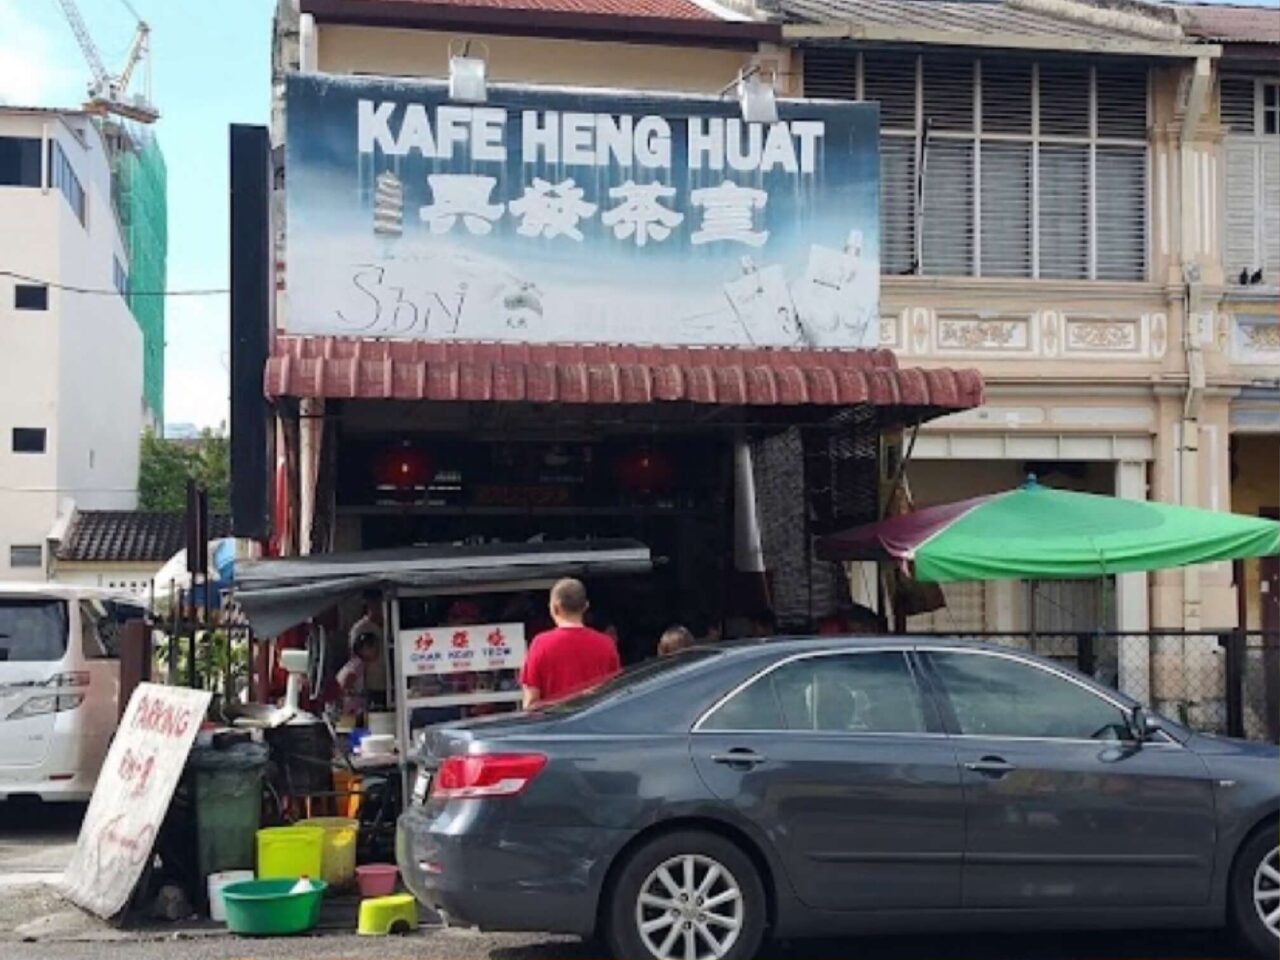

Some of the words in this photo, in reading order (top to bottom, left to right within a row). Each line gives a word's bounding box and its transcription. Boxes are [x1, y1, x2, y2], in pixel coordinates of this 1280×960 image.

[358, 99, 507, 162] KAFE
[522, 109, 671, 168] HENG
[688, 115, 825, 173] HUAT
